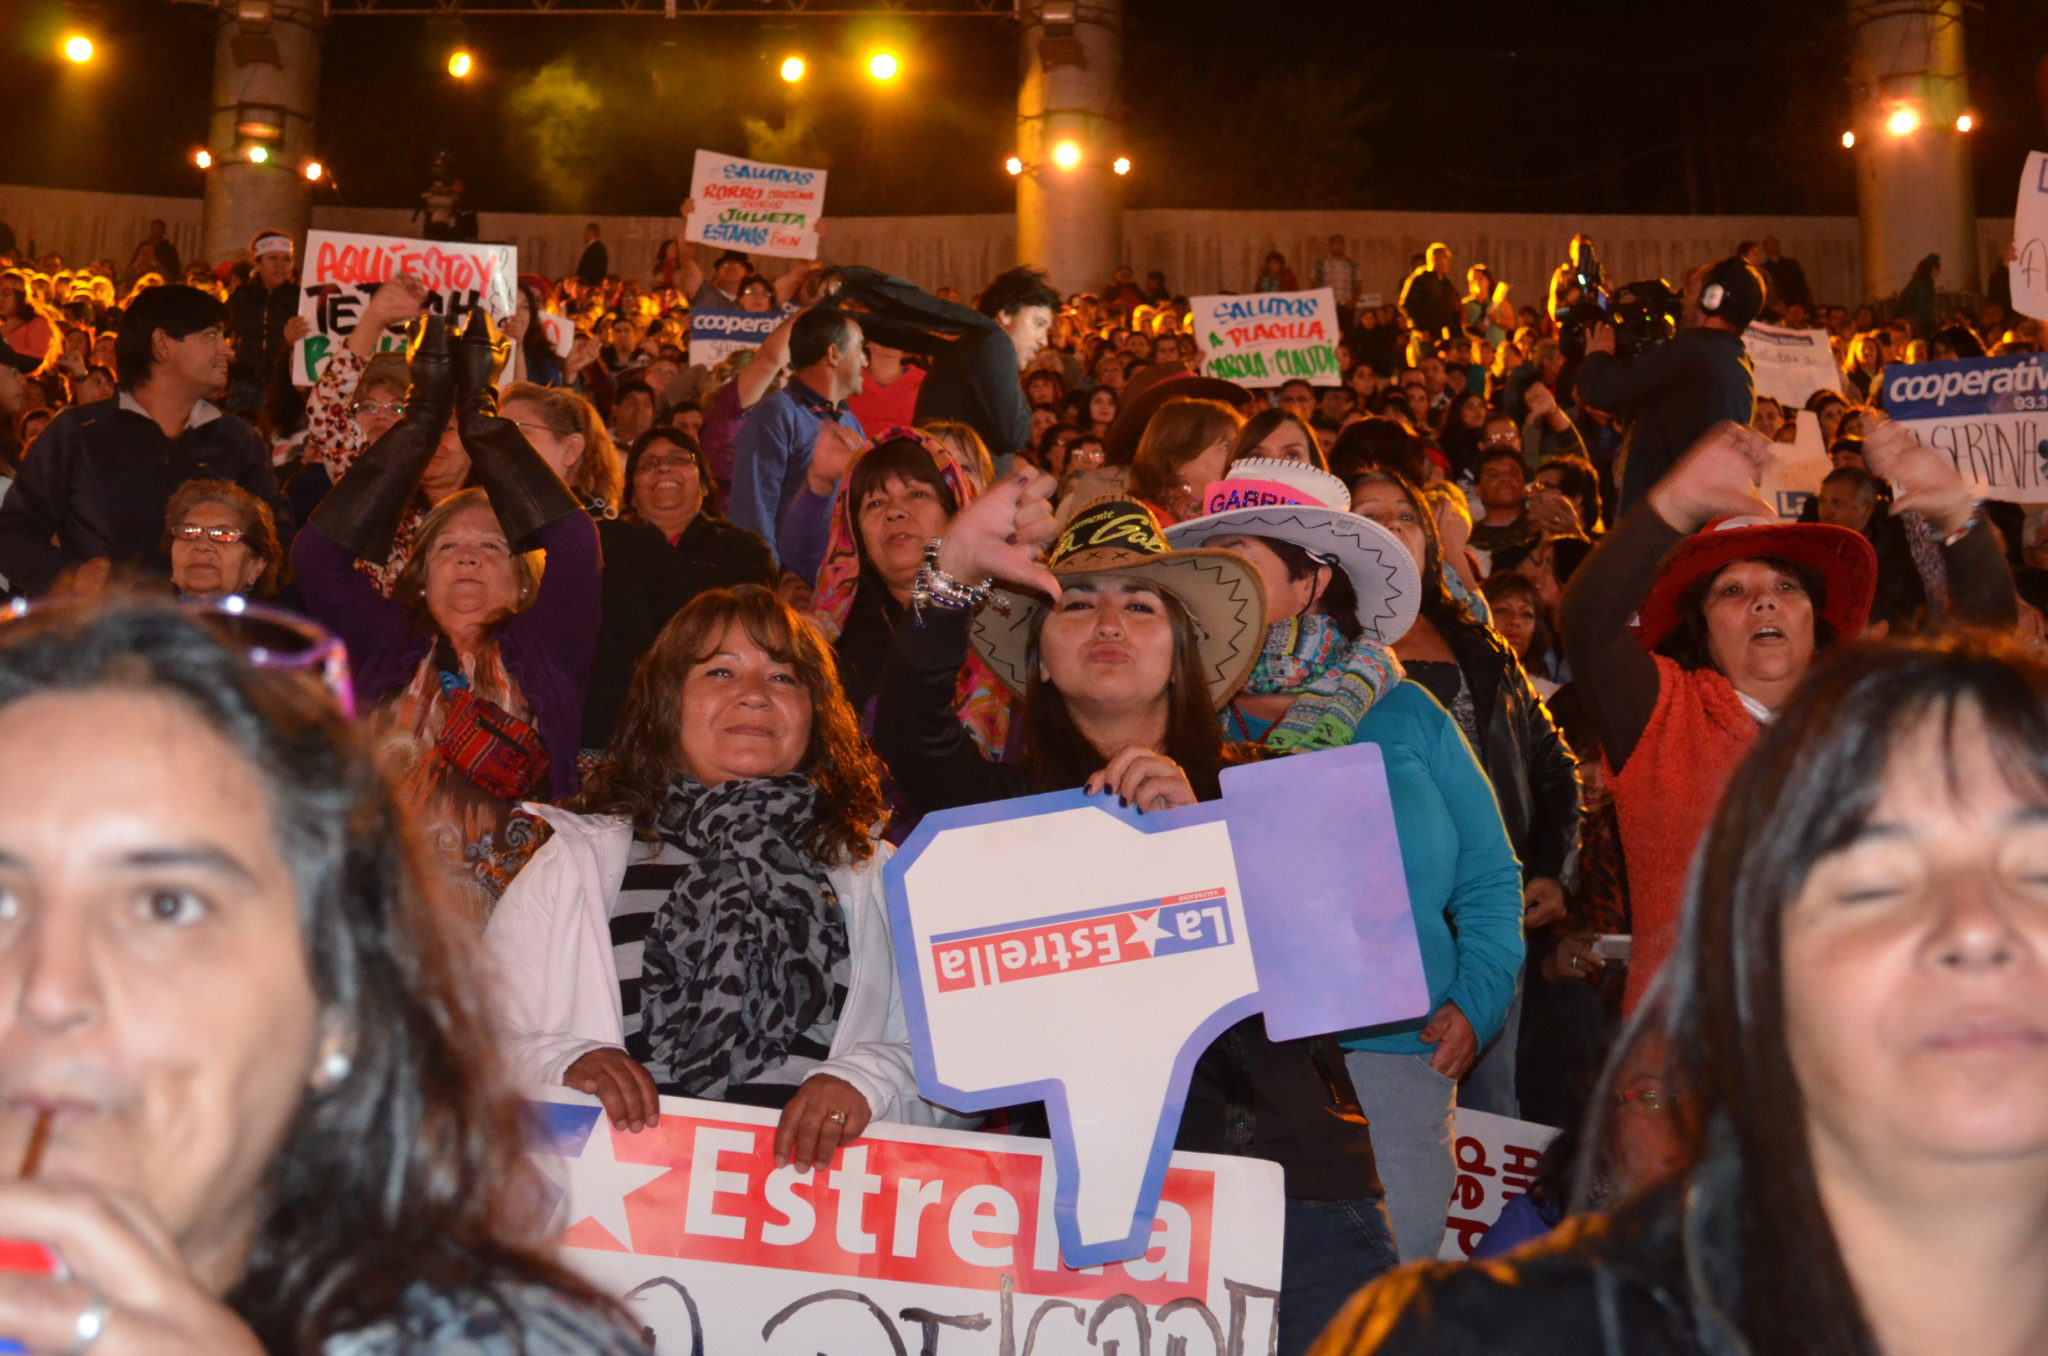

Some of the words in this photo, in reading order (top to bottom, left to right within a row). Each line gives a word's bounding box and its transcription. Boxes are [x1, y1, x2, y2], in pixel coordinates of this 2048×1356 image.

[400, 247, 498, 299] ESTOY
[1213, 298, 1319, 325] SALUDOS
[1176, 905, 1229, 946] La
[938, 924, 1122, 988] Estrella
[684, 1125, 1192, 1284] Estrela
